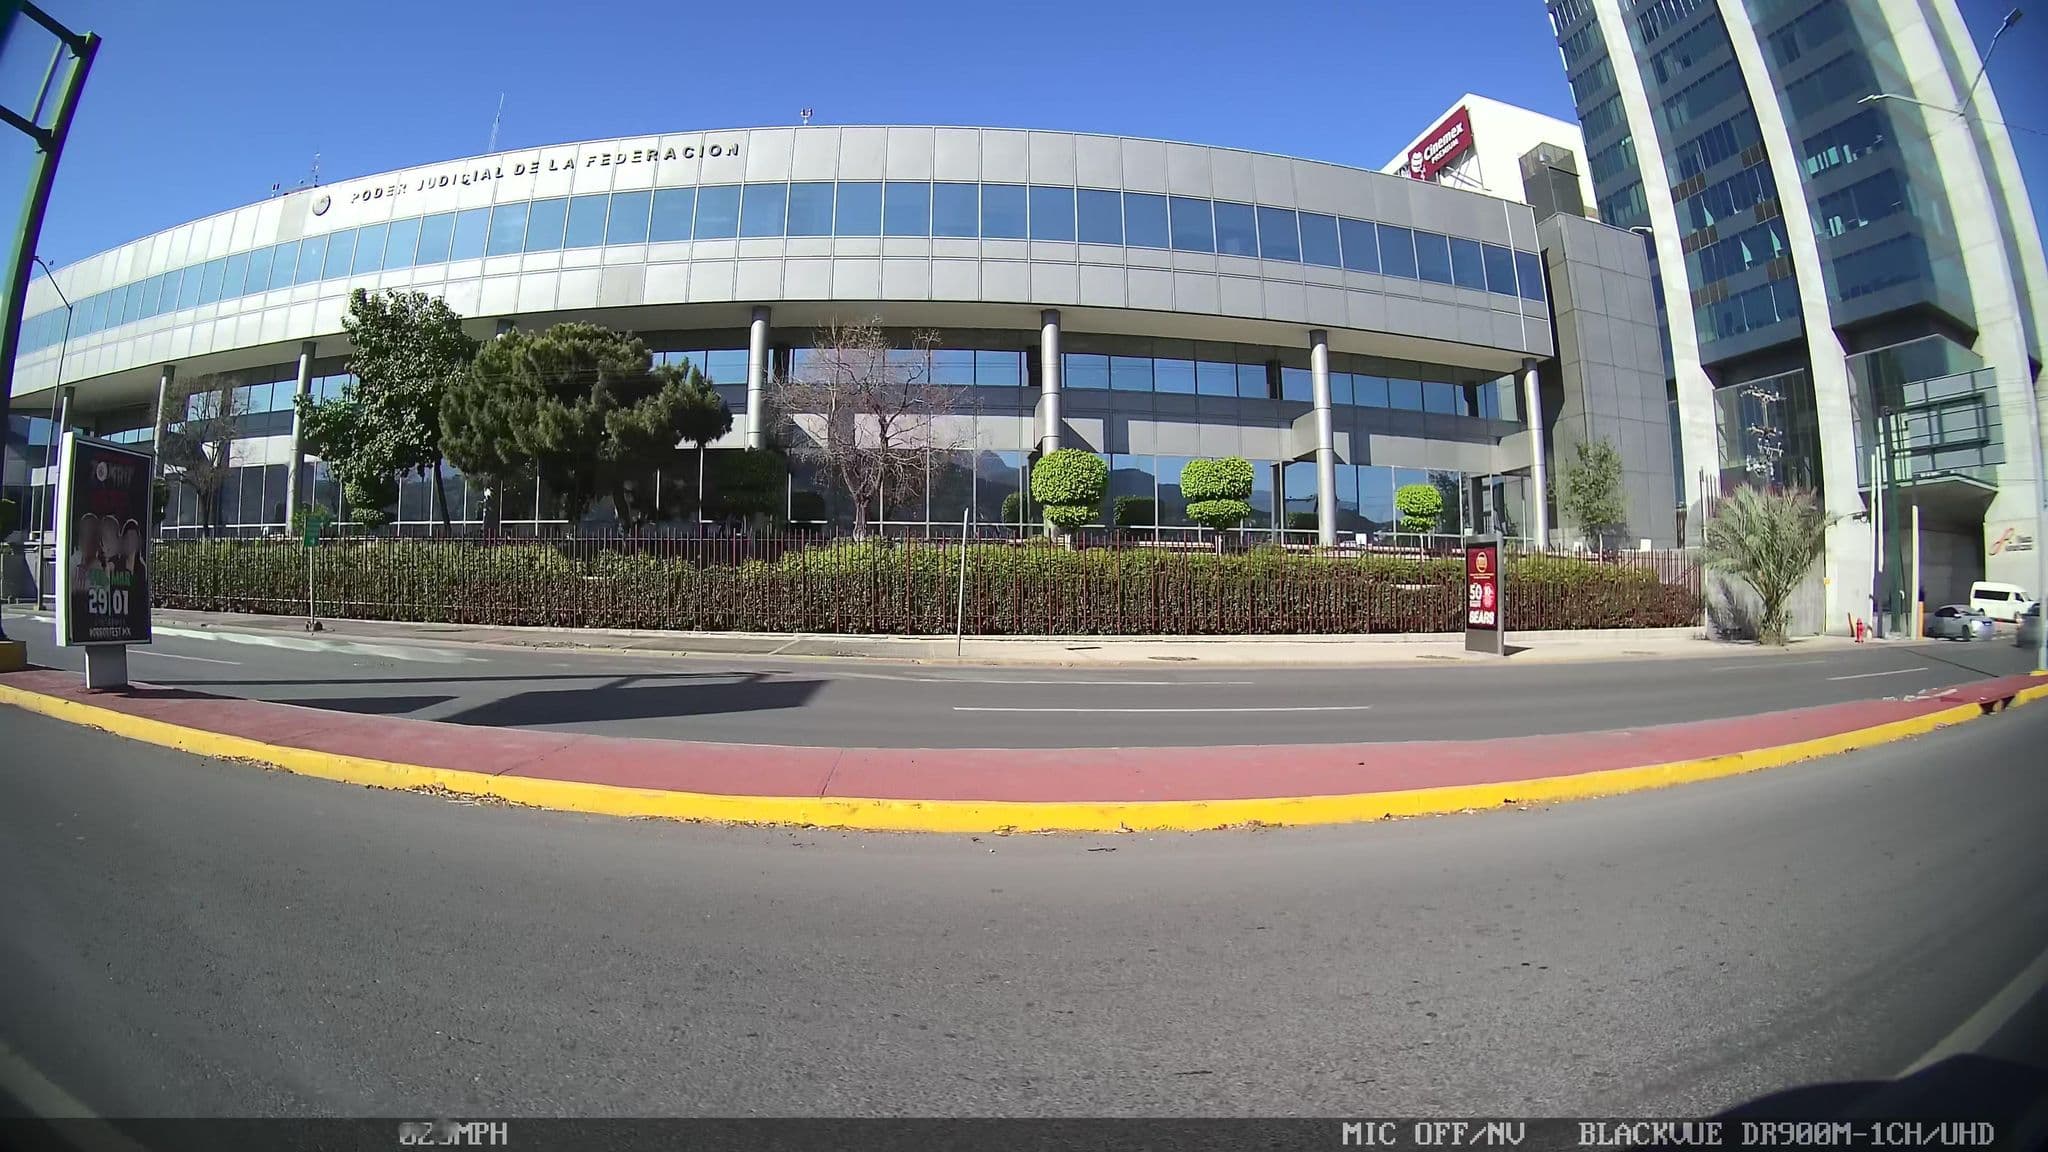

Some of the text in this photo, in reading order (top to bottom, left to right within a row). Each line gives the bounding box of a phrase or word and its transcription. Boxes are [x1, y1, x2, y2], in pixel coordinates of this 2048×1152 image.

[1423, 122, 1464, 161] Cinemex
[349, 143, 739, 205] PODER JUDICIAL DE LA FEDERACION
[88, 588, 129, 615] 29 01
[1469, 583, 1483, 600] 50
[1469, 610, 1495, 625] SEARS
